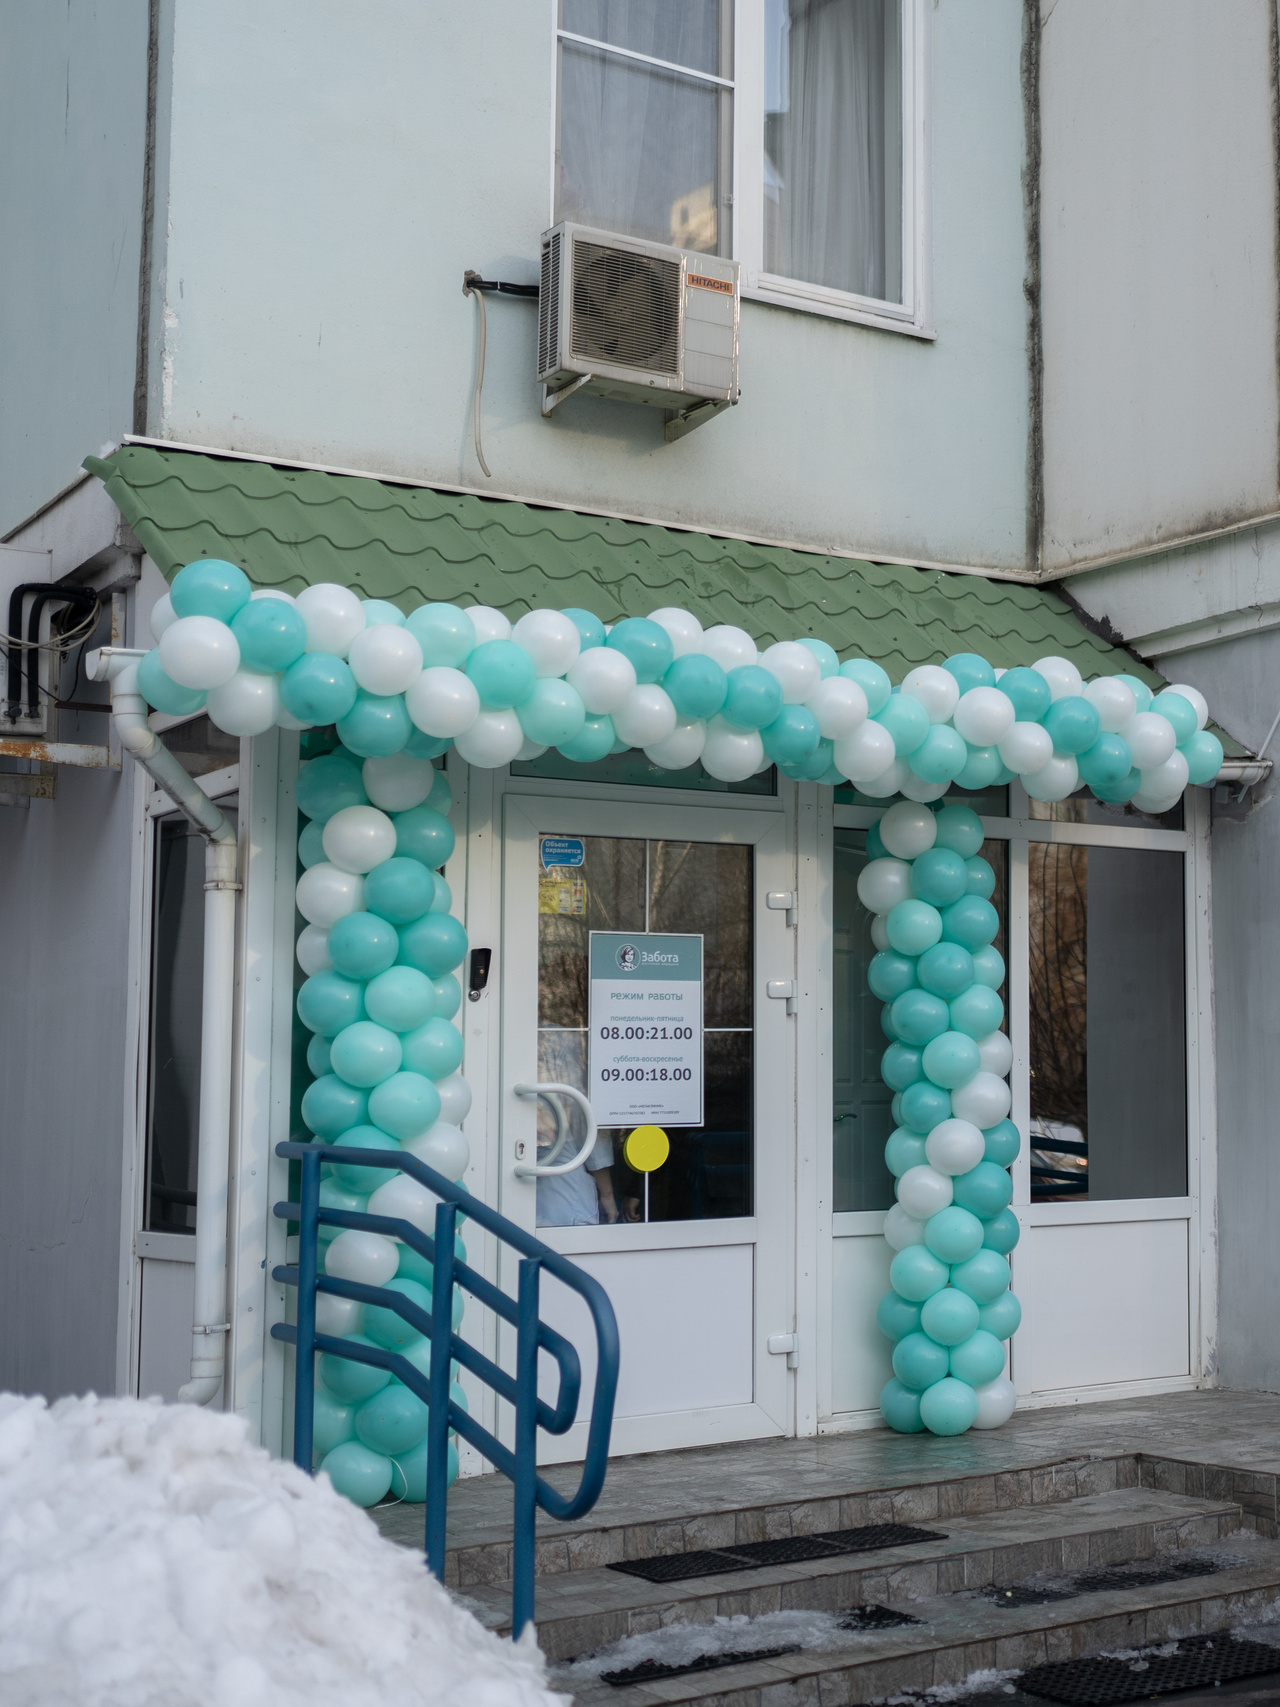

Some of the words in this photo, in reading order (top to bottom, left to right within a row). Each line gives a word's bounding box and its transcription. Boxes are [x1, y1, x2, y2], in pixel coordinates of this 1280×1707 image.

[691, 276, 730, 291] HITACHI
[545, 840, 569, 848] Объект
[641, 951, 679, 963] Забота
[600, 1026, 693, 1040] 08.00:21.00
[612, 1055, 684, 1064] суббота-воскресенье
[601, 1068, 692, 1081] 09.00:18.00
